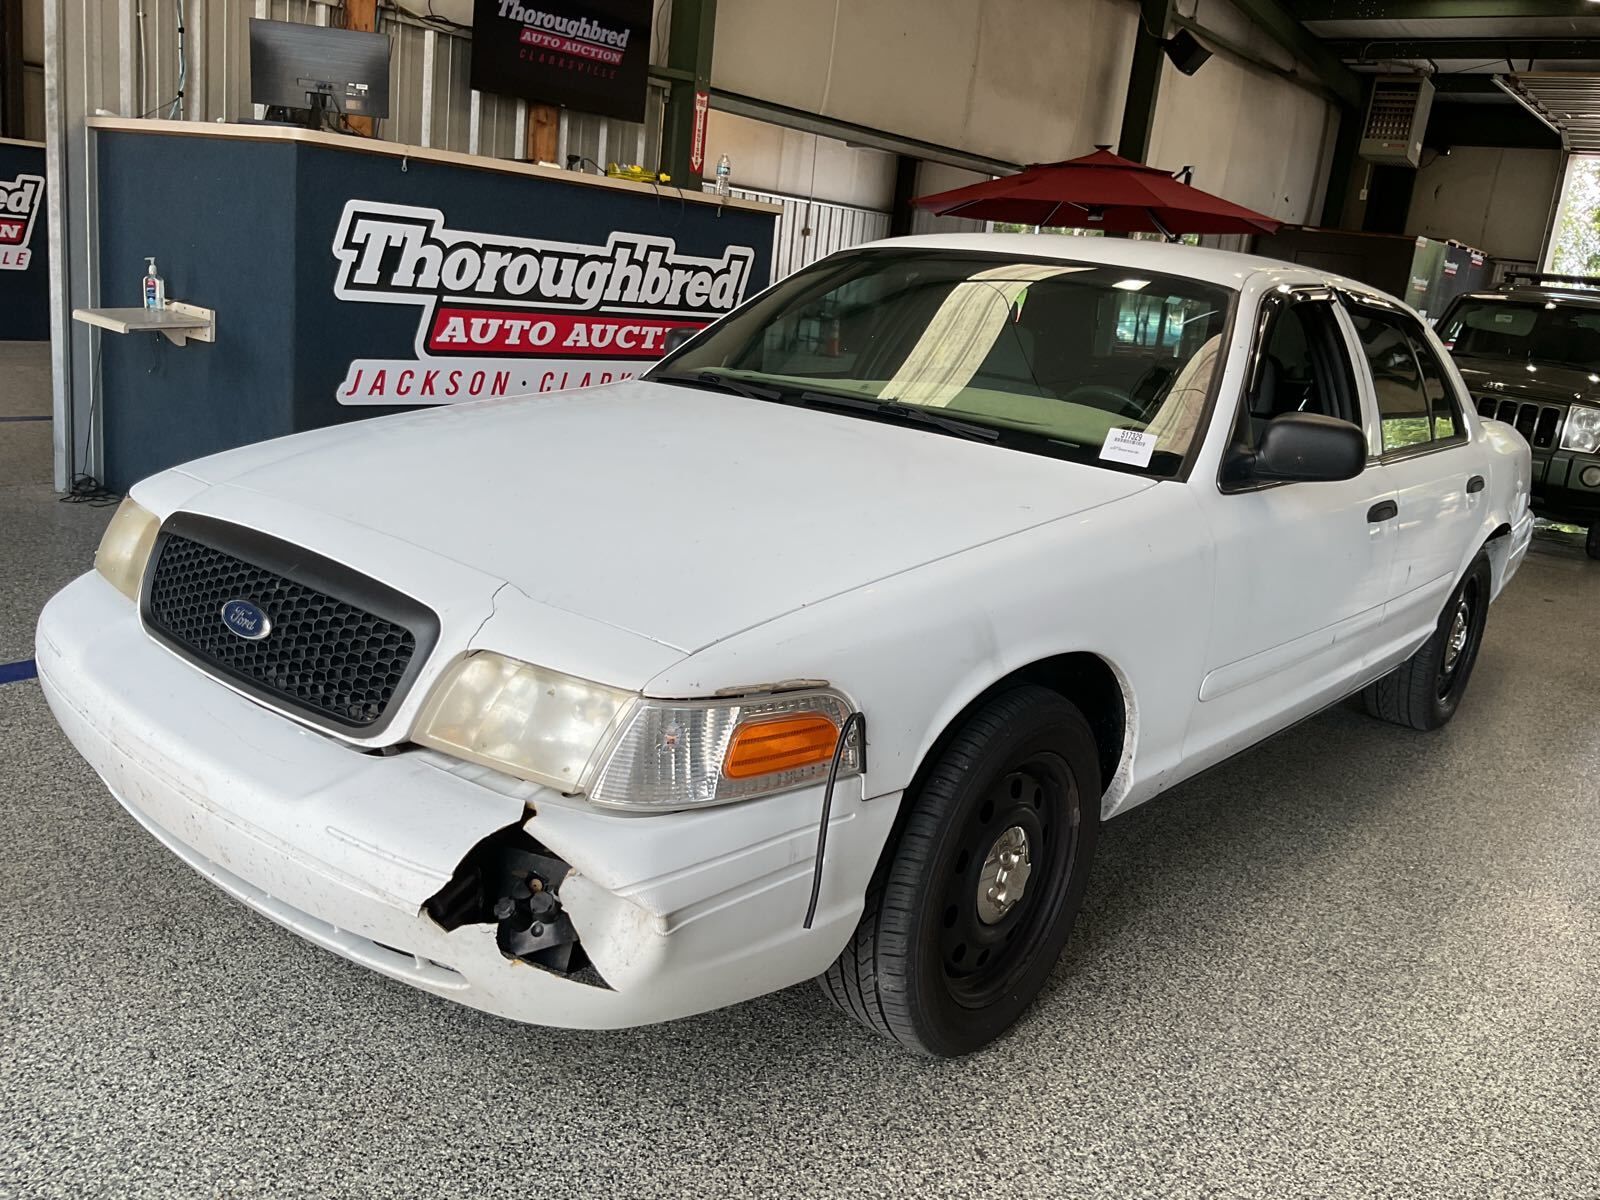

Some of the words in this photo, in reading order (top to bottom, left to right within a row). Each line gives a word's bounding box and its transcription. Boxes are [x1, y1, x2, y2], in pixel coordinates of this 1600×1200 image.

[498, 0, 630, 48] Thoroughbred
[521, 31, 560, 48] AUTO
[562, 41, 622, 63] AUCTION
[352, 219, 742, 309] Thoroughbred
[436, 316, 556, 345] AUTO
[346, 369, 511, 397] JACKSON
[230, 606, 257, 630] Ford
